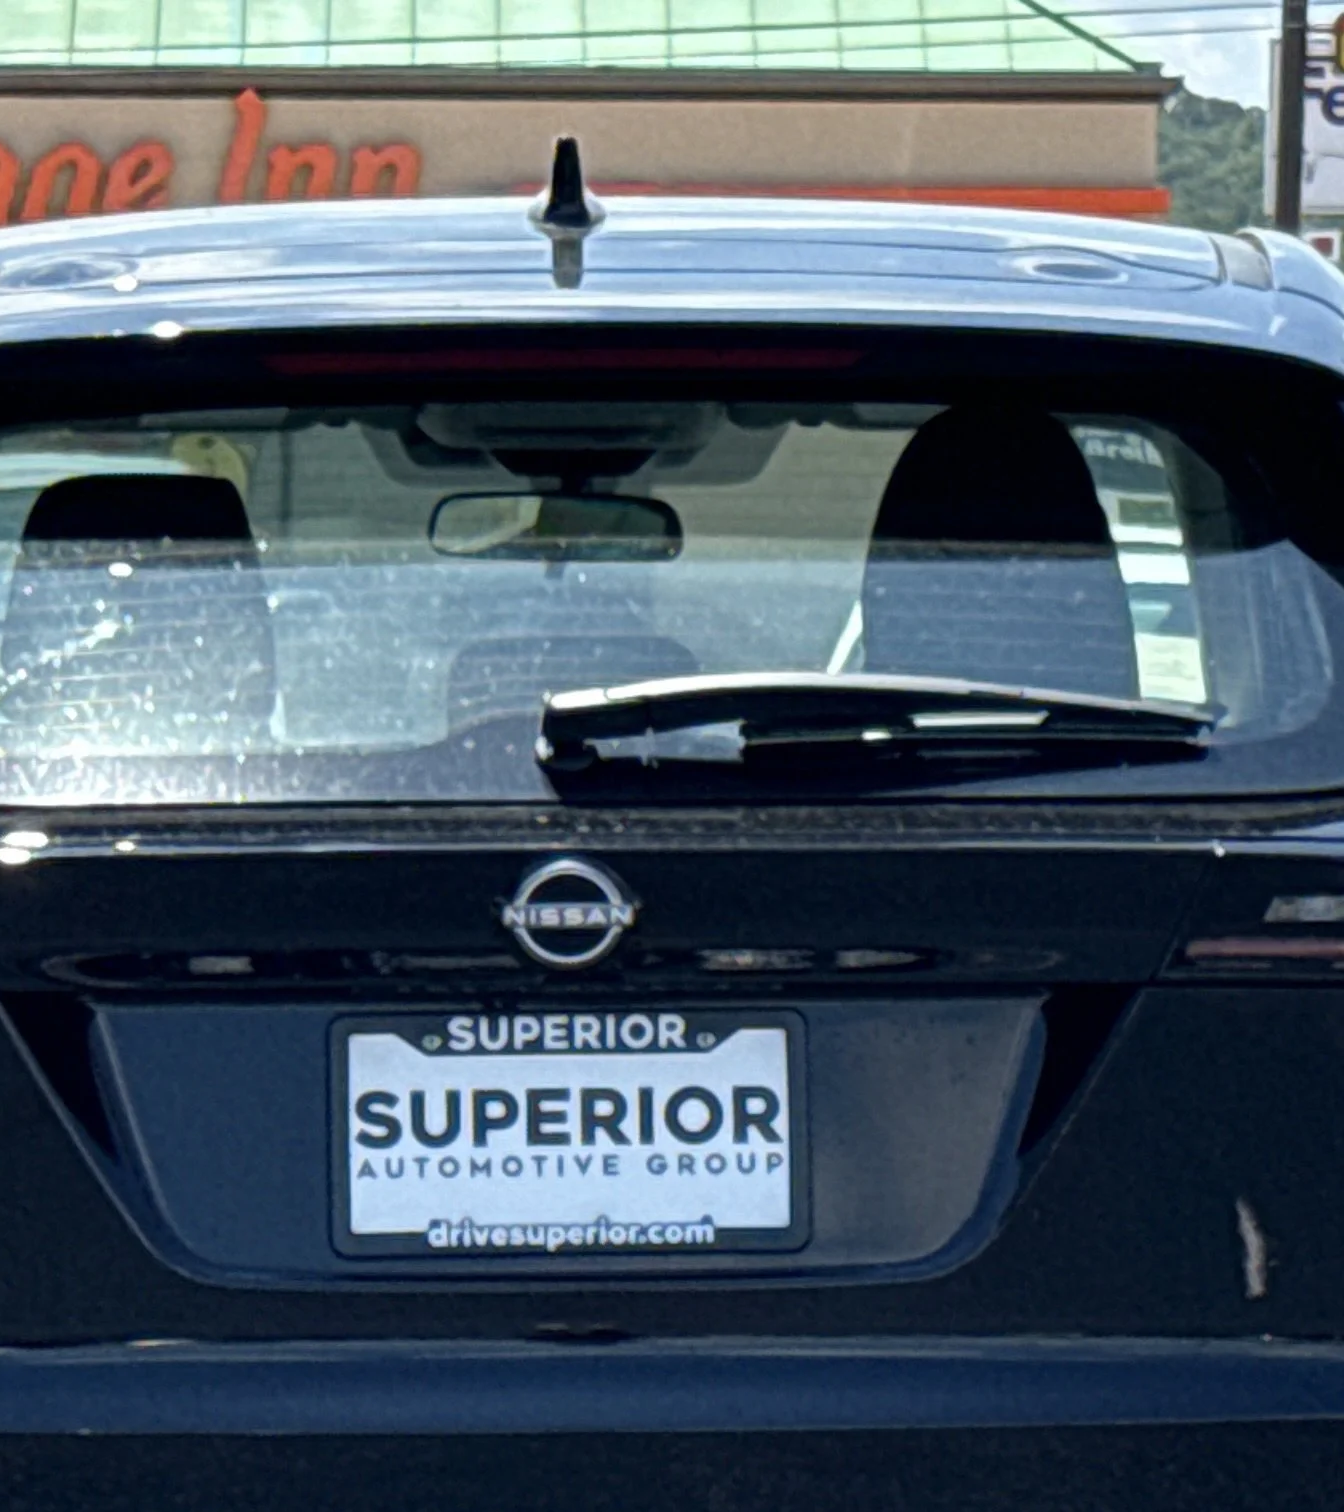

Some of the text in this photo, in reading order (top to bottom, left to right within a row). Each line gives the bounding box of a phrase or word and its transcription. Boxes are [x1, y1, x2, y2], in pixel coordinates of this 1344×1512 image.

[220, 87, 423, 202] Inn
[504, 905, 633, 927] NISSAN
[446, 1012, 687, 1052] SUPERIOR
[354, 1084, 784, 1149] SUPERIOR
[356, 1151, 785, 1181] AUTOMOTIVE GROUP
[427, 1215, 715, 1252] drivesuperior.com
